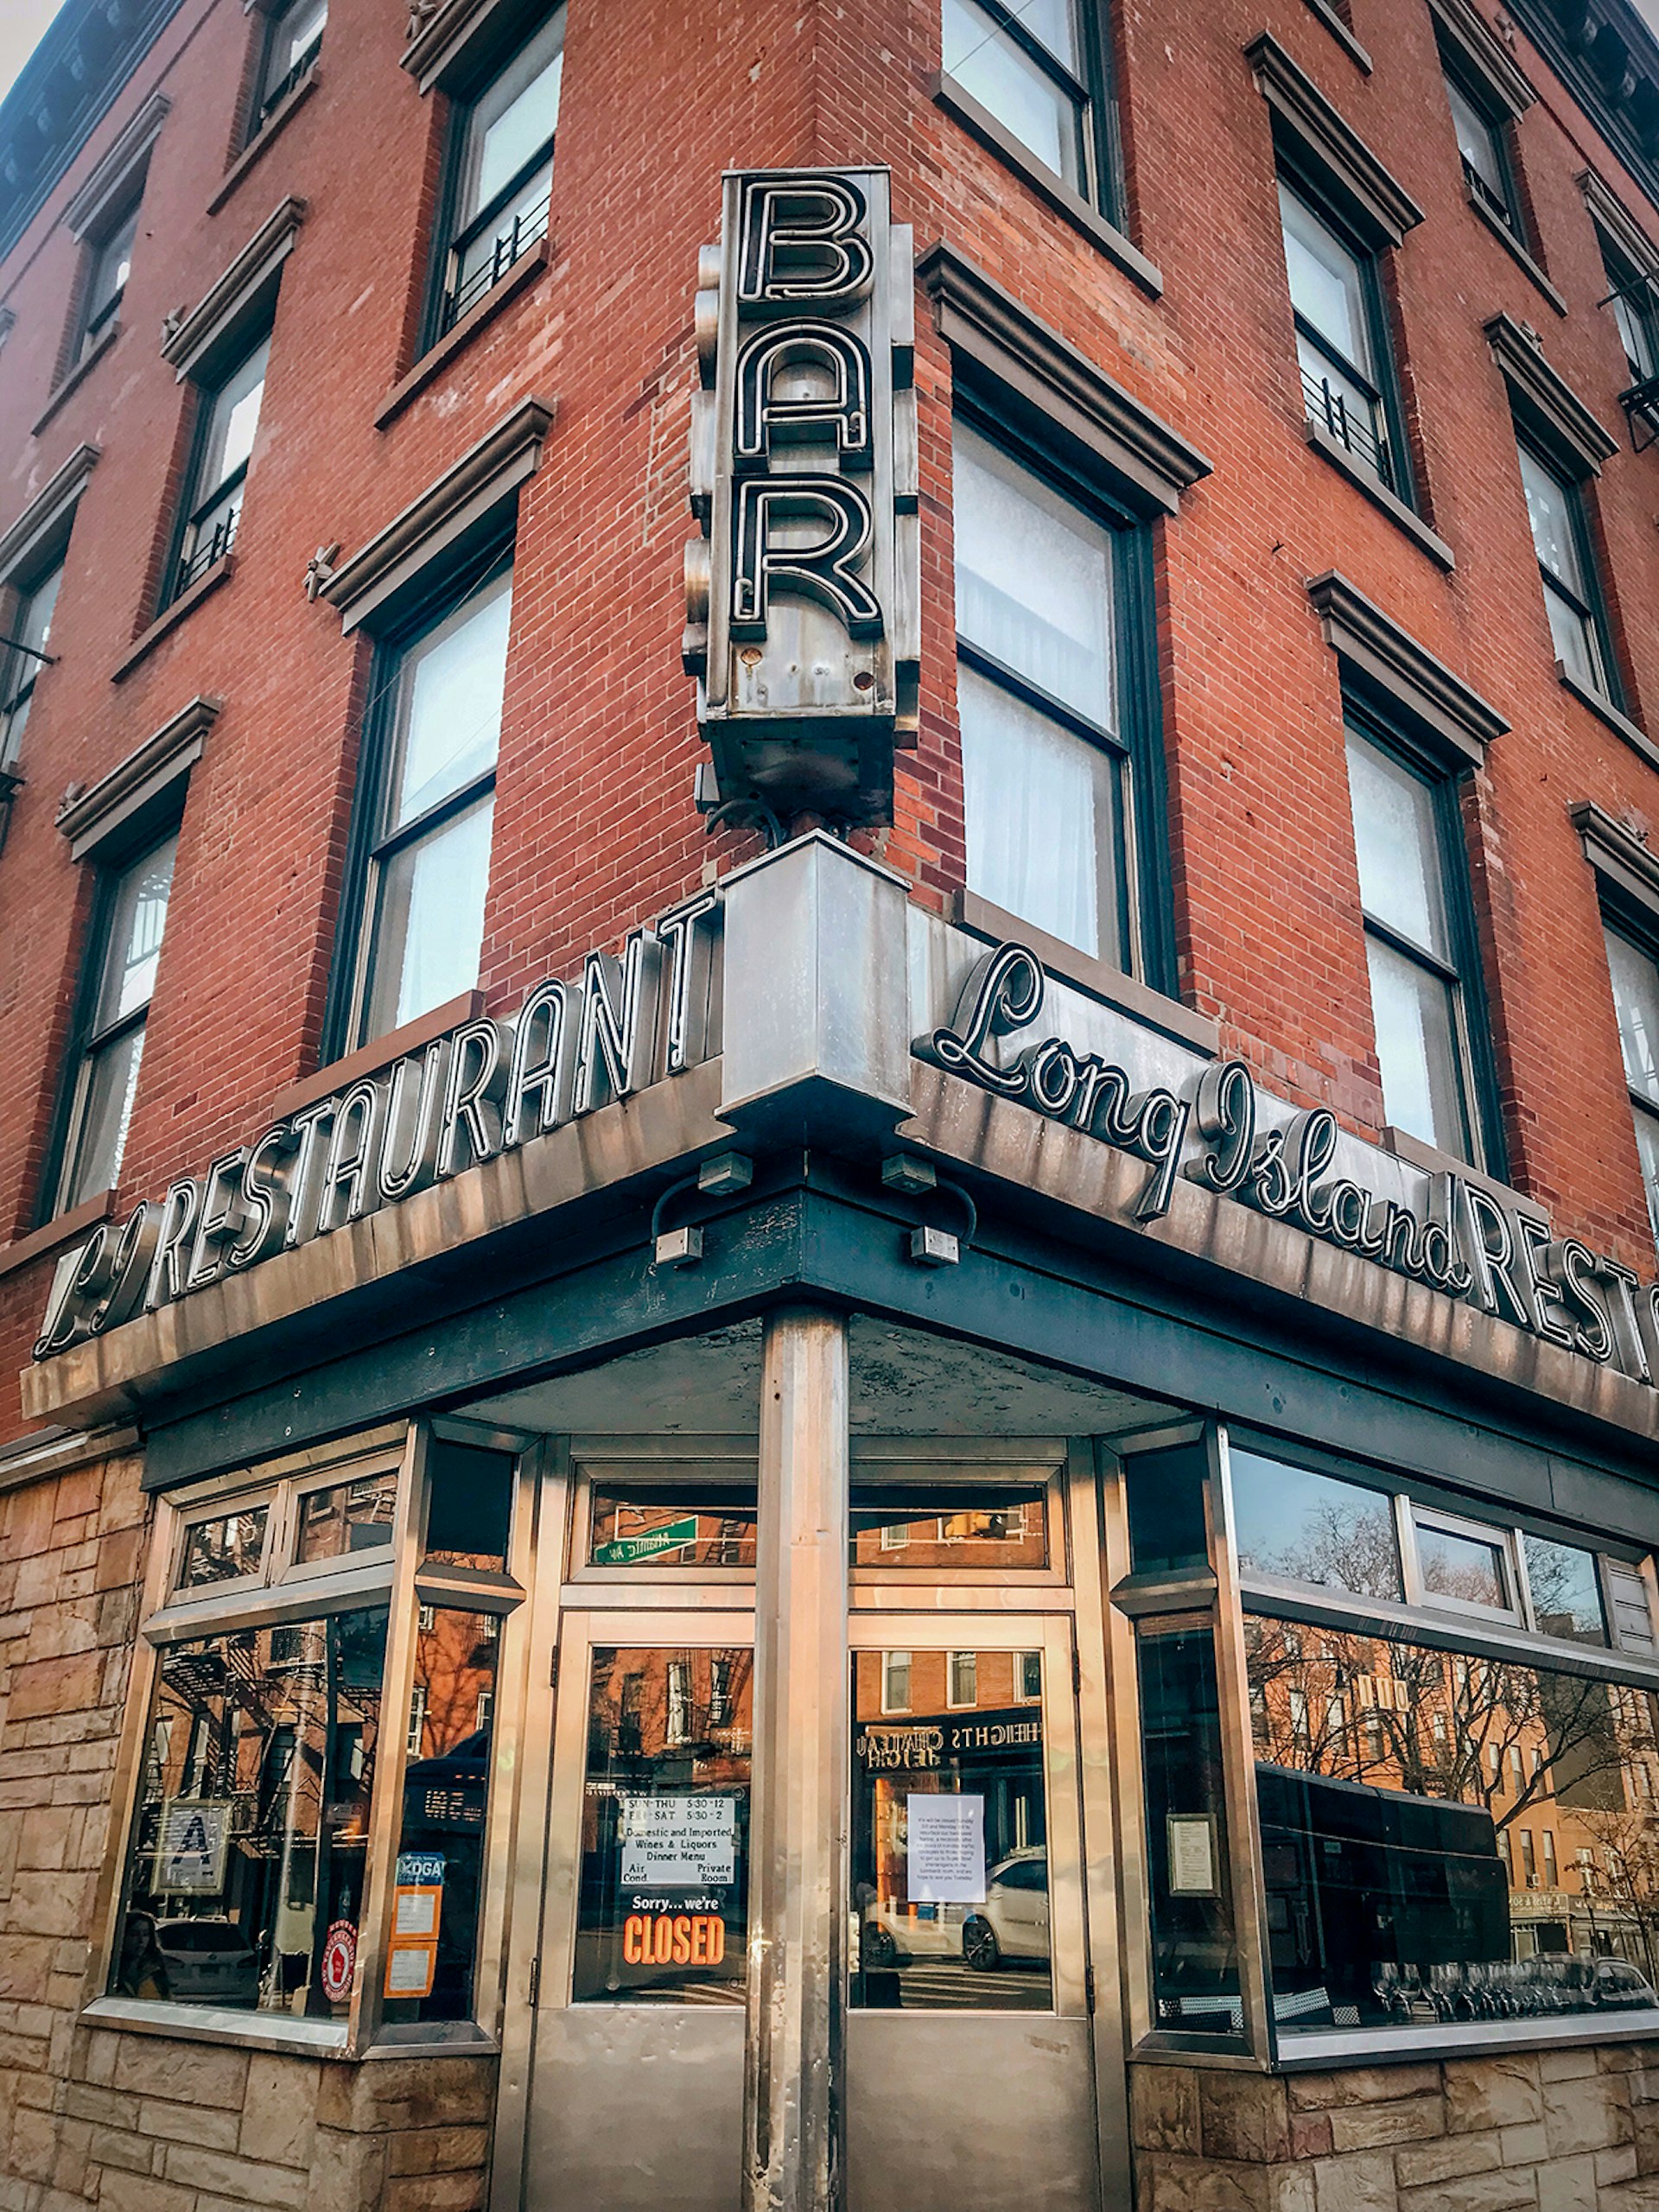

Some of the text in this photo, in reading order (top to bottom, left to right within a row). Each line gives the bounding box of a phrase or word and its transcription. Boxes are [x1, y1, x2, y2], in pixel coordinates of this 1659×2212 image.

[730, 175, 883, 639] BAR
[143, 888, 722, 1313] RESTAURANT
[914, 940, 1659, 1384] Long Island REST
[671, 1828, 687, 1837] and
[690, 1827, 732, 1838] Imported
[636, 1840, 664, 1849] Wines
[681, 1840, 717, 1850] Liquors
[646, 1852, 705, 1860] Dinner Menu
[629, 1864, 645, 1872] Air
[697, 1863, 732, 1872] Private
[623, 1873, 647, 1882] Cond
[701, 1873, 728, 1882] Room
[684, 1896, 719, 1910] we're
[623, 1914, 725, 1966] CLOSED
